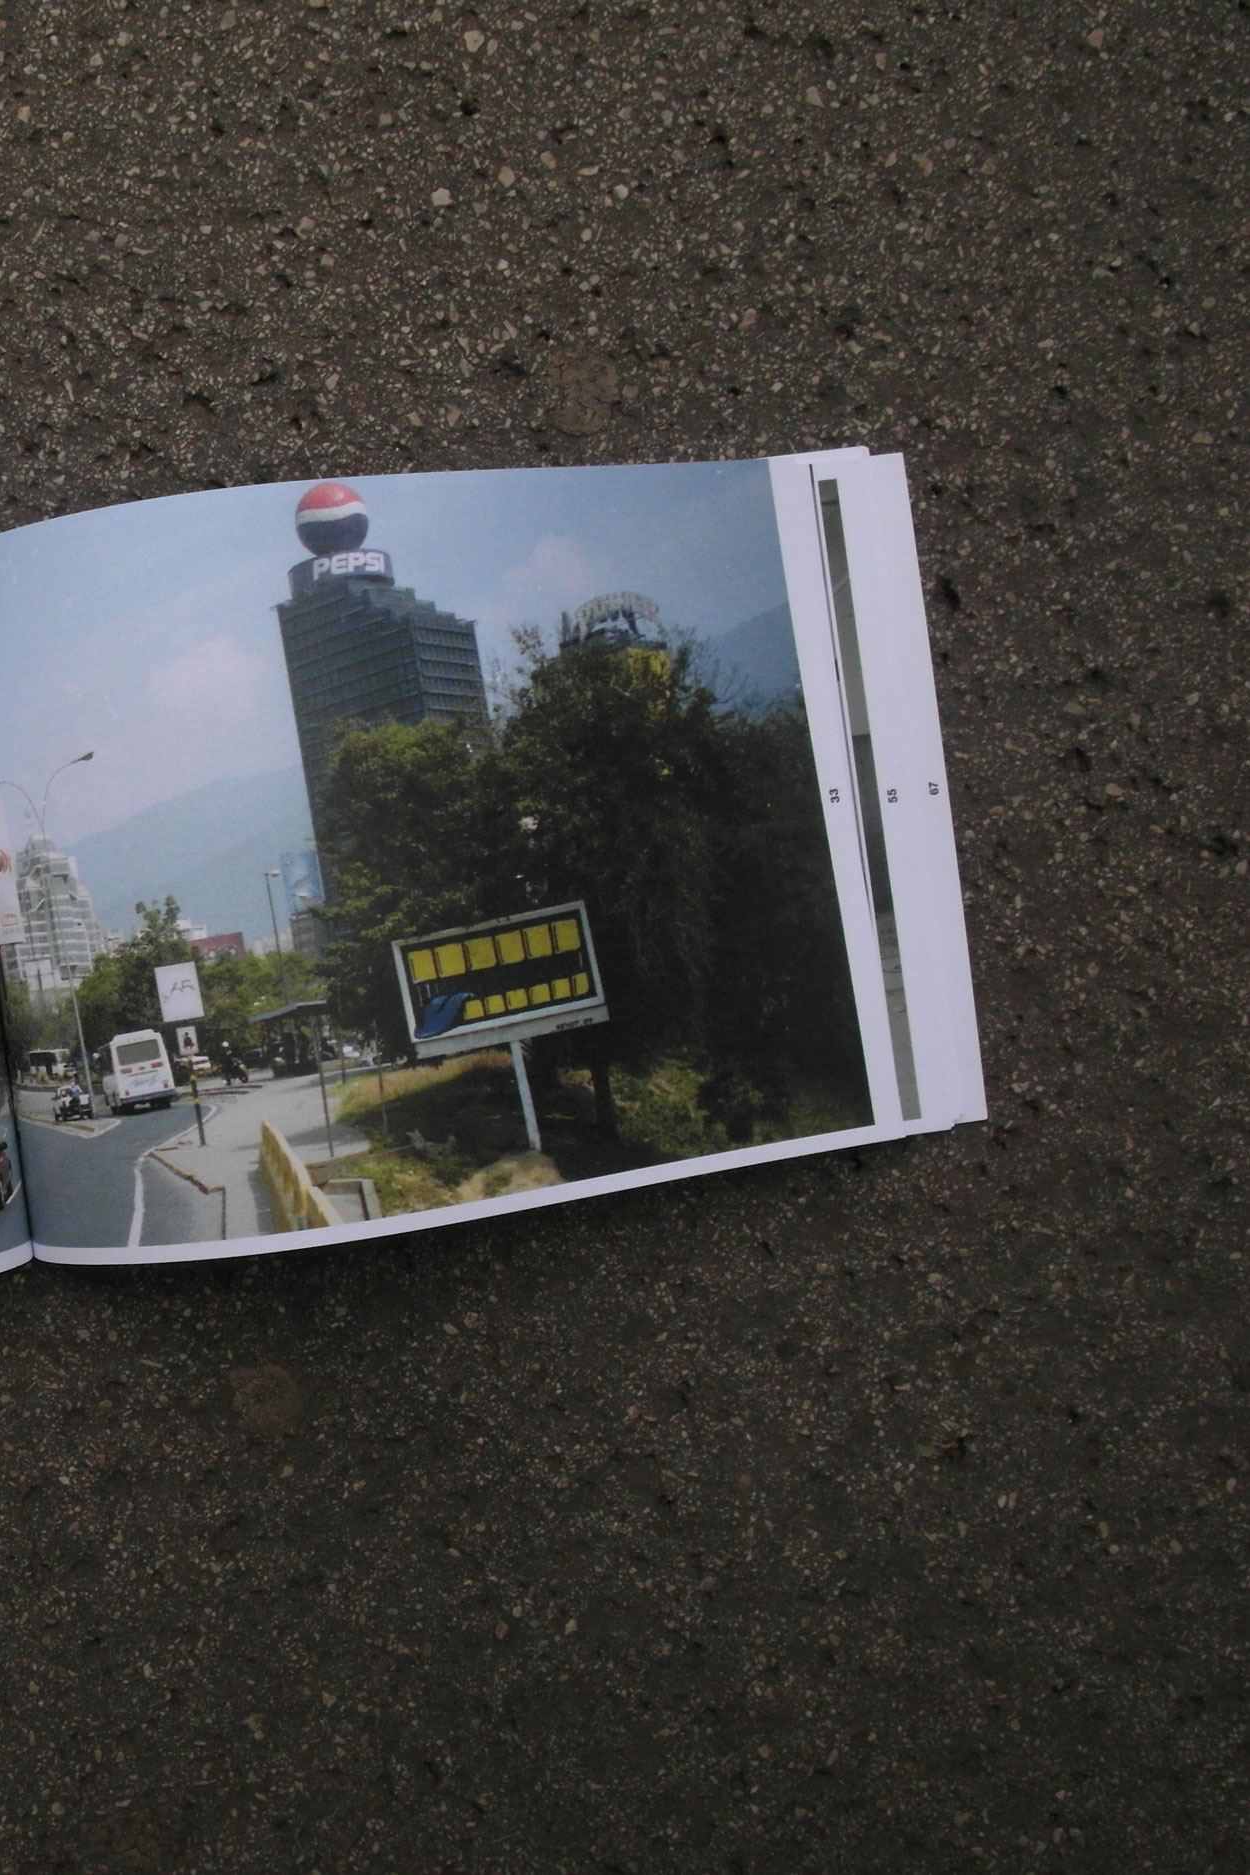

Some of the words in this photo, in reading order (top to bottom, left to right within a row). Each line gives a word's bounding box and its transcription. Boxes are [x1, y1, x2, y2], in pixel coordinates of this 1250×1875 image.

[313, 552, 385, 580] PEPSI
[829, 788, 840, 803] 33
[887, 788, 898, 803] 55
[928, 782, 939, 796] 67
